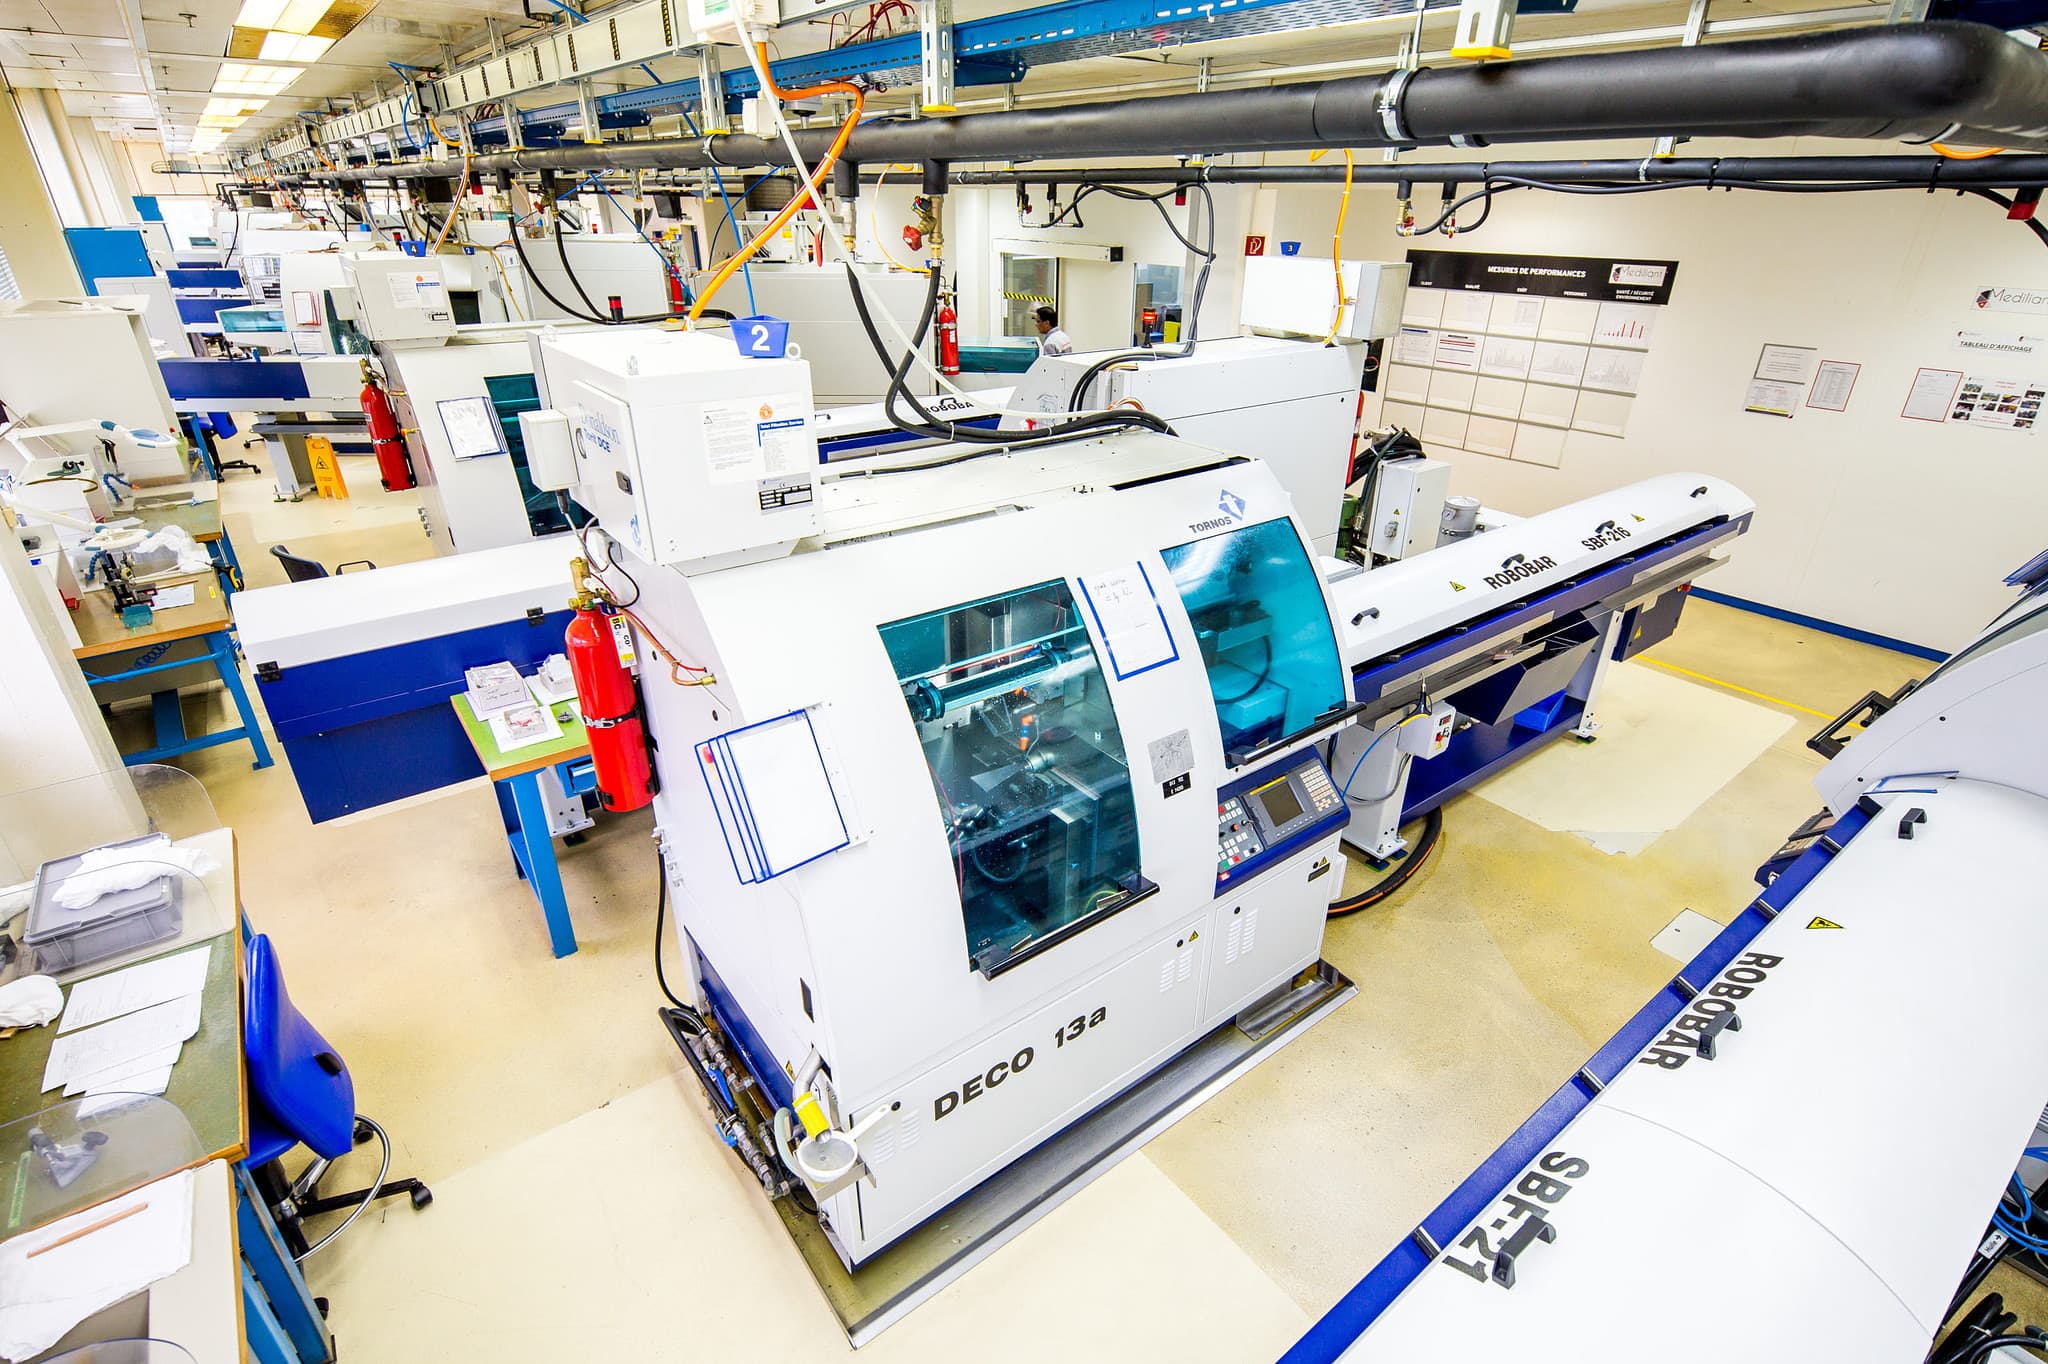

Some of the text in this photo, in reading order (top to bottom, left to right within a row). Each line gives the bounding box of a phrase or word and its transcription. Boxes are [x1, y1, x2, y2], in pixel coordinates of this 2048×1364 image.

[1287, 244, 1293, 252] 3
[1487, 265, 1586, 278] MESURES DE PERFORMANCES
[751, 324, 770, 352] 2
[1960, 341, 2033, 353] TABLEAU D'AFFICHAGE
[597, 436, 611, 453] DCE
[1188, 516, 1232, 533] TORNOS
[1581, 526, 1632, 551] SBF-216
[1483, 555, 1558, 590] ROBOBAR
[612, 617, 622, 630] BC
[1638, 951, 1785, 1070] ROBOBAR
[934, 1006, 1107, 1121] DECO 13a
